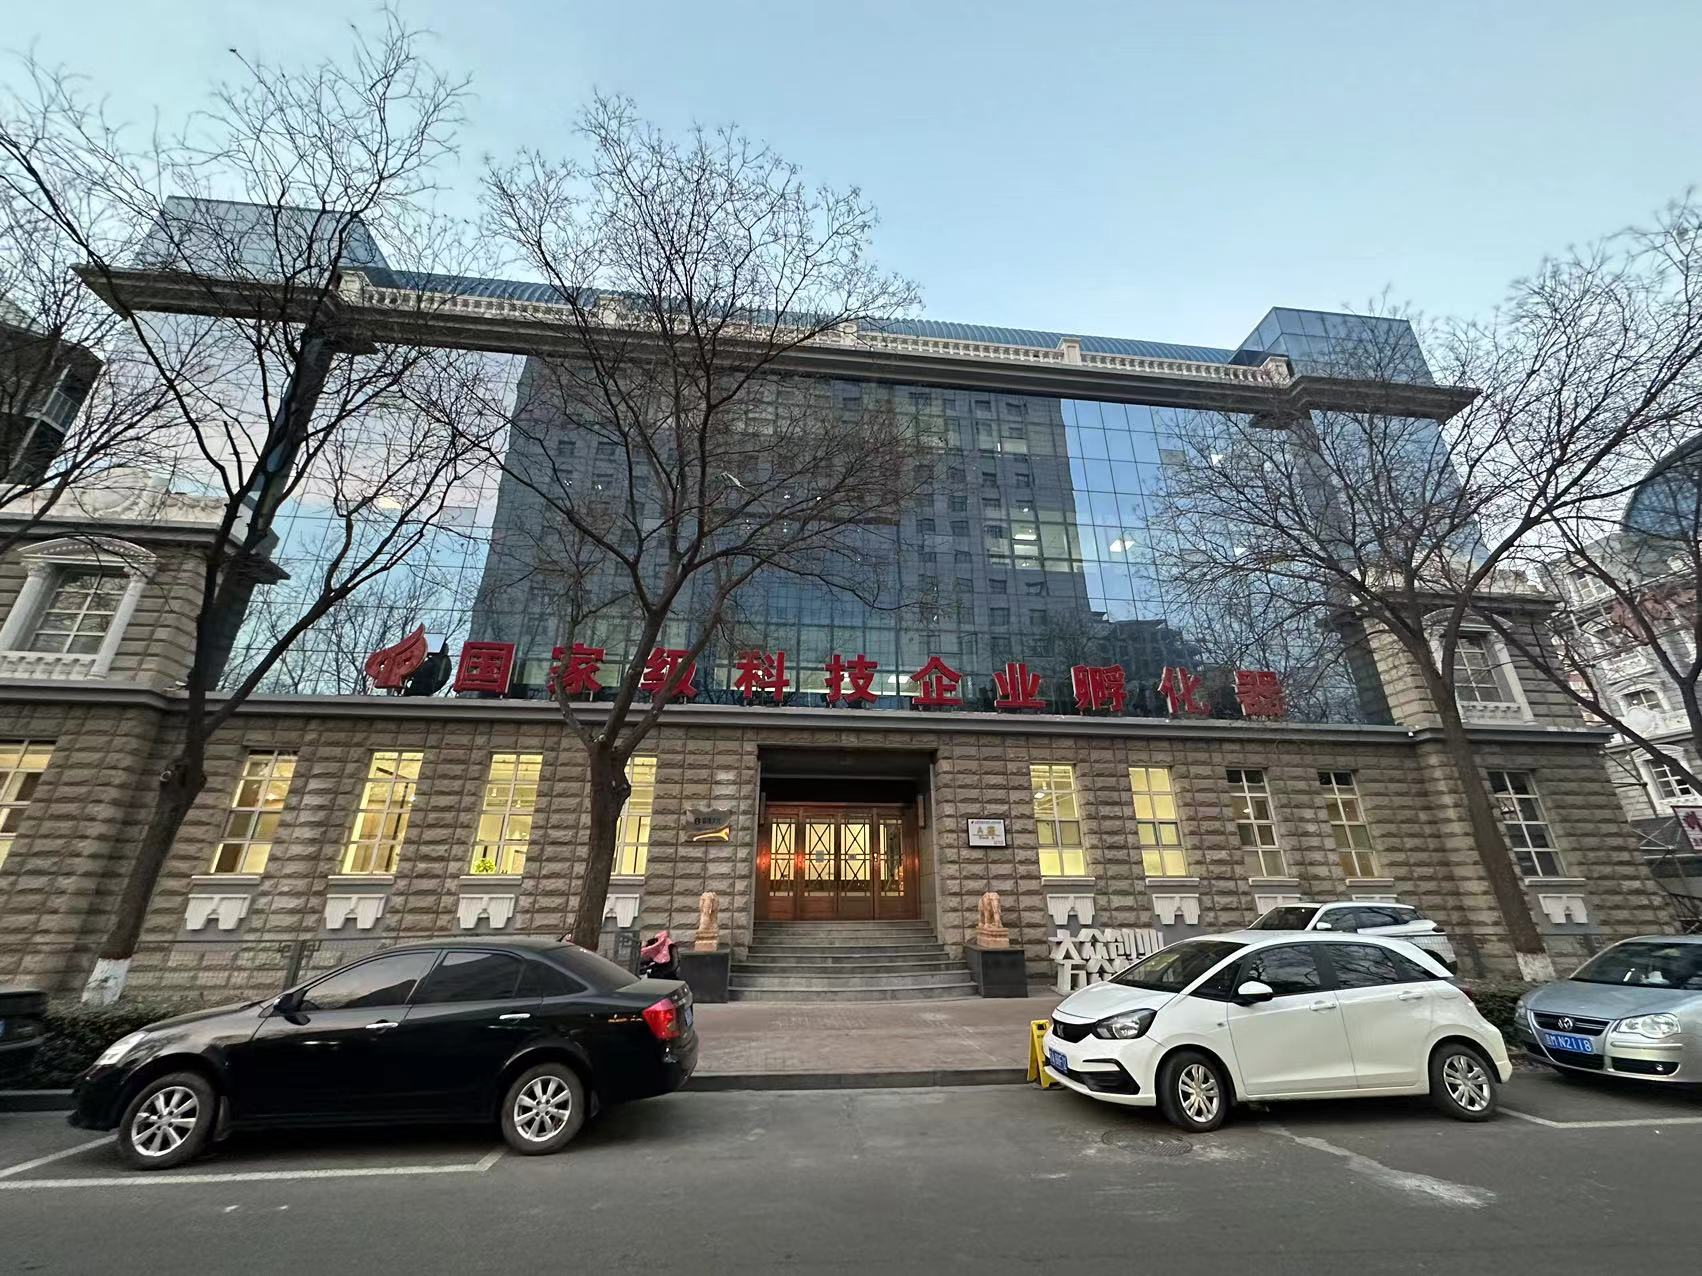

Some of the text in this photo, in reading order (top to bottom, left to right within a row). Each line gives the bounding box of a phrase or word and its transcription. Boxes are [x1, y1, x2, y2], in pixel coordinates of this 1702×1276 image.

[453, 640, 1287, 718] 国家级科技企业孵化器
